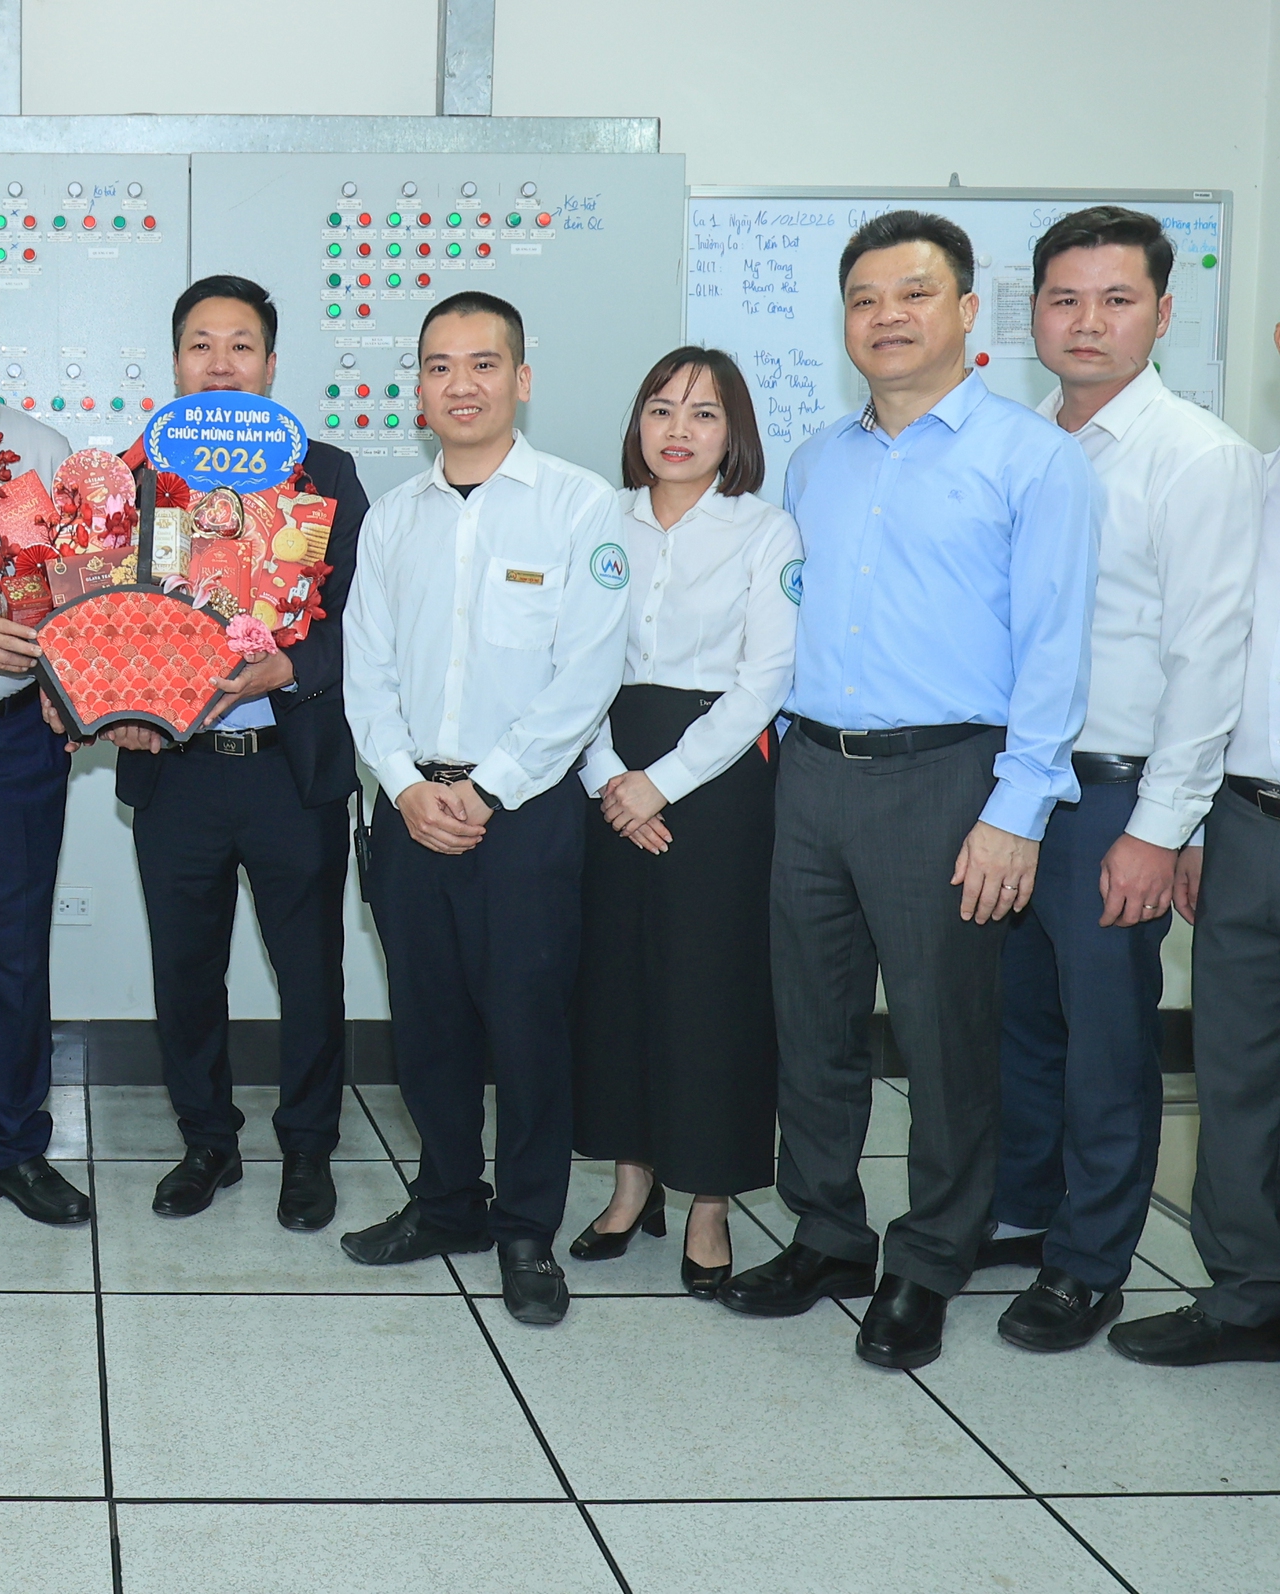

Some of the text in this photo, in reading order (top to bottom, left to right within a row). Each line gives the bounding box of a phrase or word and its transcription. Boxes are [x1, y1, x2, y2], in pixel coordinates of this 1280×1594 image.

[692, 210, 705, 227] Ca
[710, 211, 720, 227] 1
[729, 213, 752, 235] Ngày
[848, 208, 867, 228] GA
[753, 349, 783, 380] Hồng
[185, 406, 270, 427] BỘ XÂY DỰNG
[768, 396, 825, 422] Duy Anh
[167, 423, 286, 443] CHÚC MỪNG NĂM MỚI
[767, 422, 792, 443] Quý
[193, 446, 267, 475] 2026
